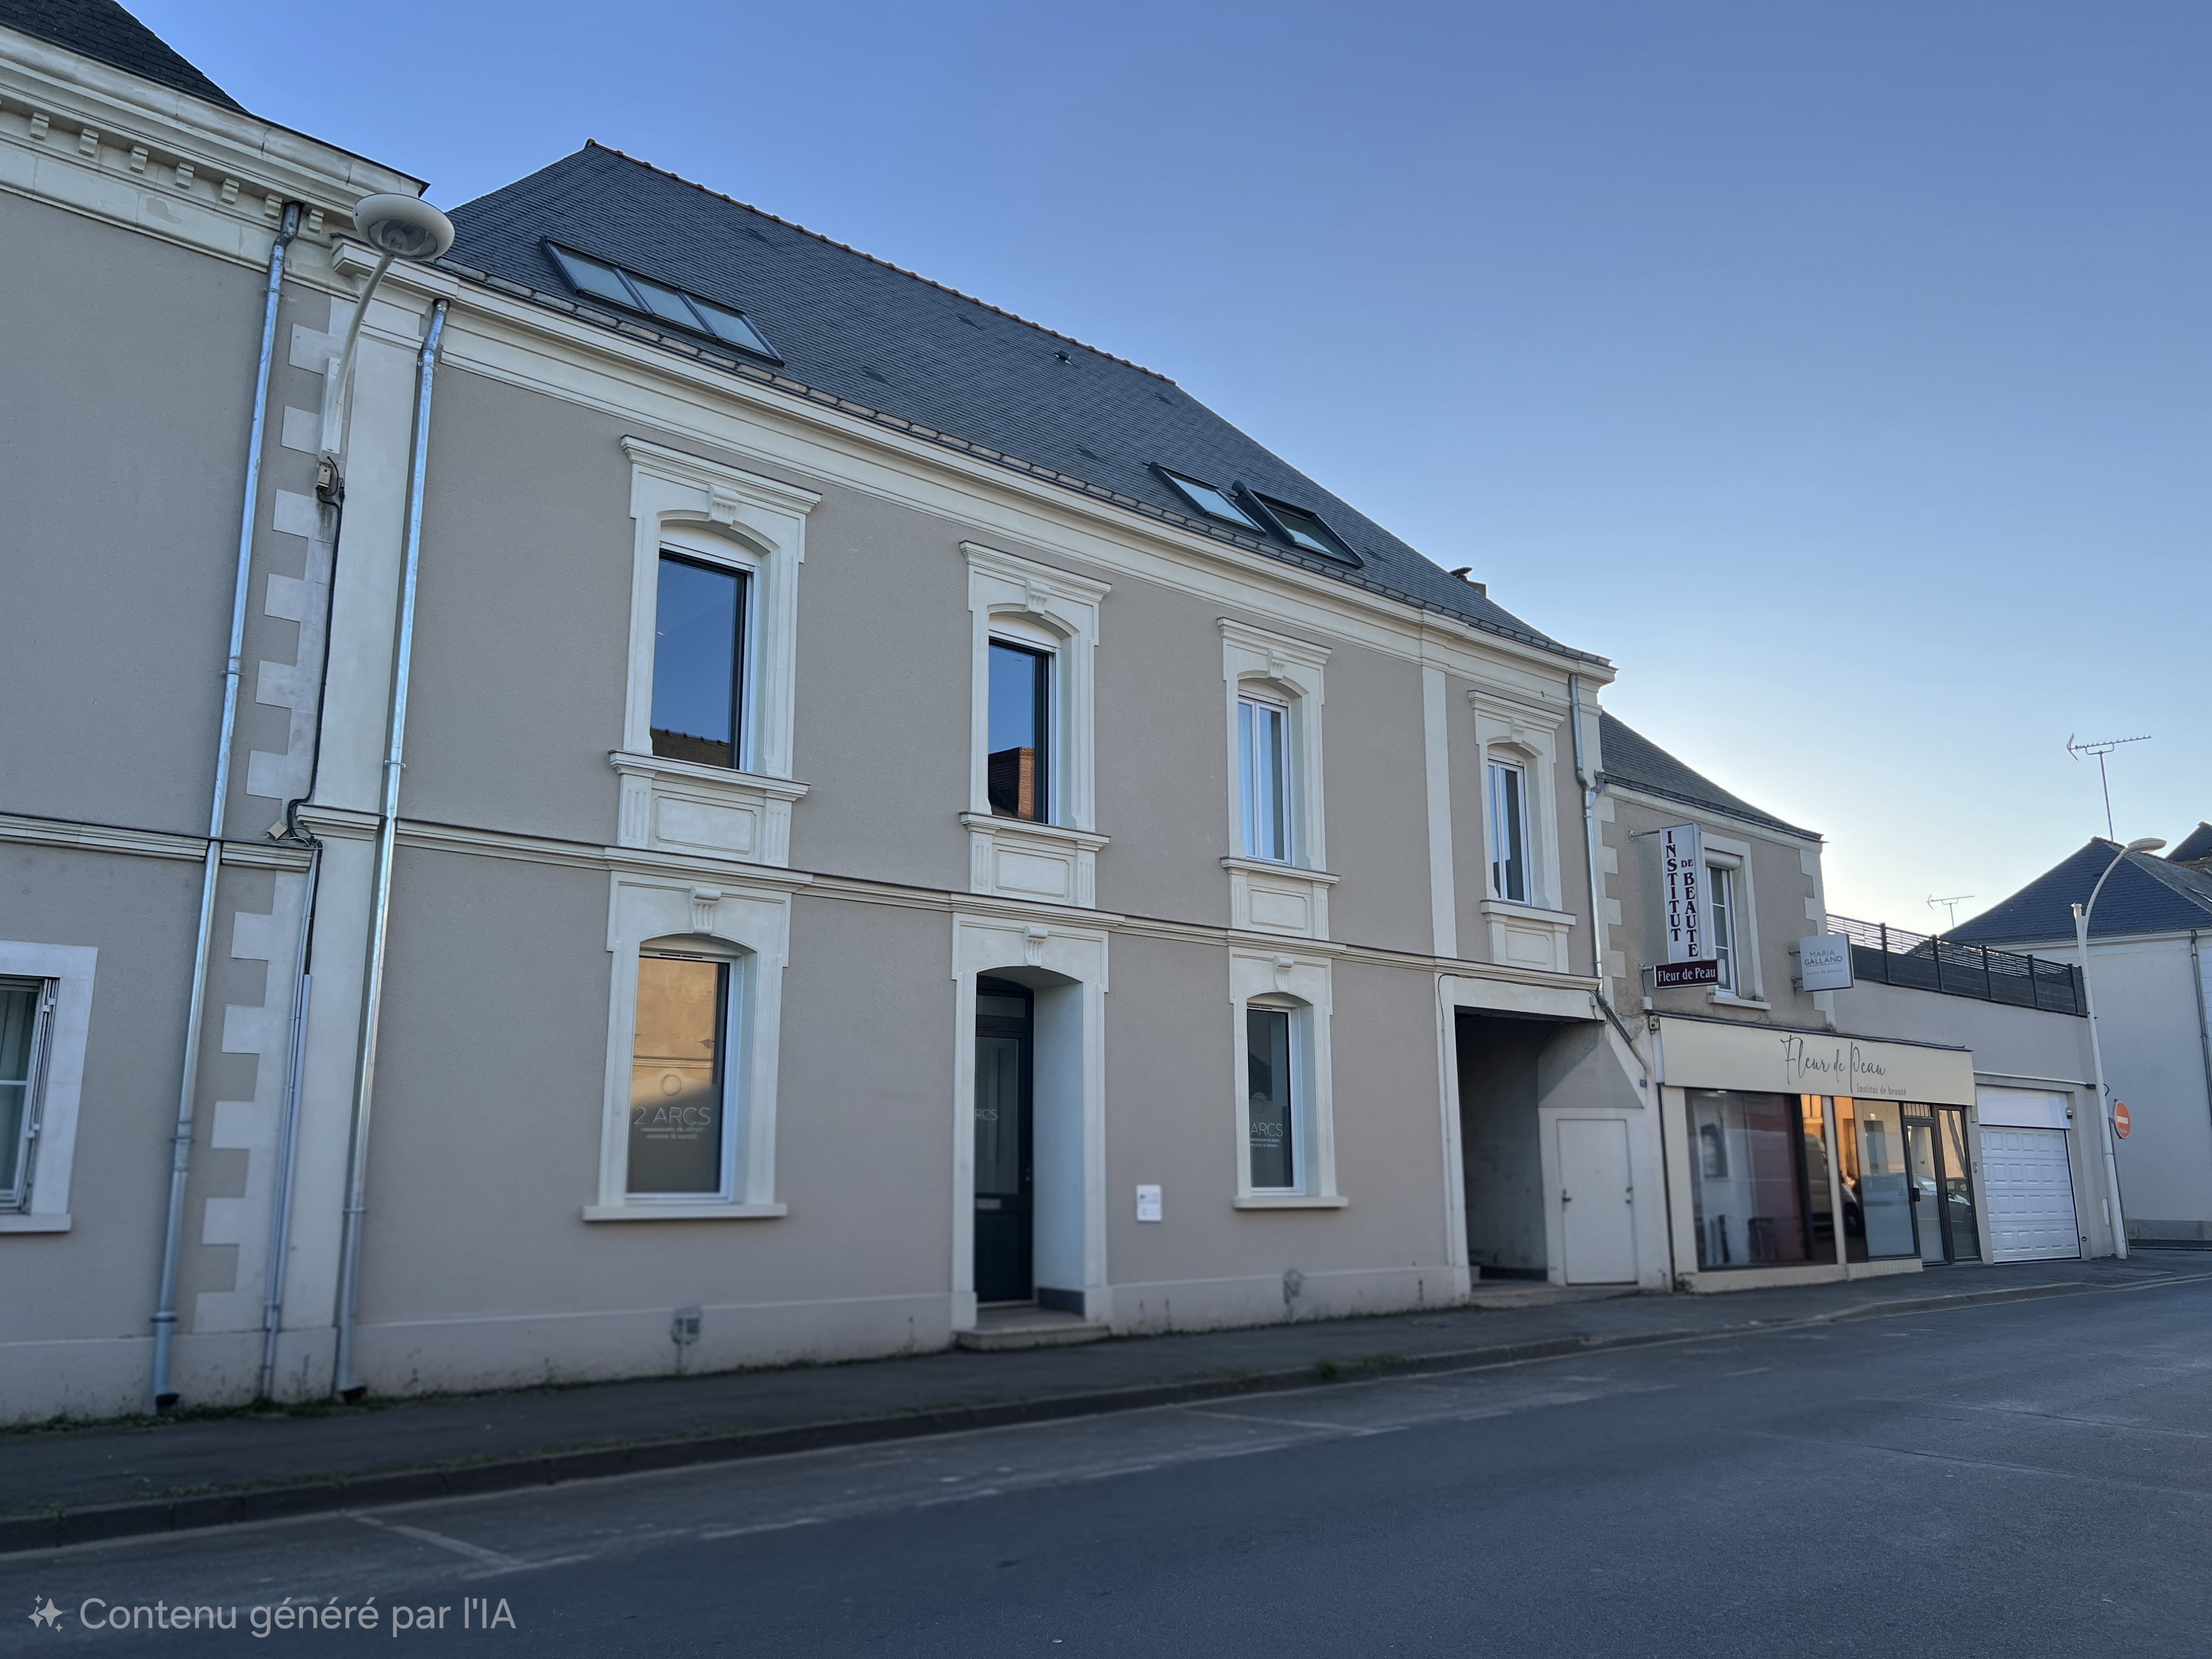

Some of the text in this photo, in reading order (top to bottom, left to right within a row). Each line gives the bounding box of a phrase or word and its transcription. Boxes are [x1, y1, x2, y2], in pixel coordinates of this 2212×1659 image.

[1666, 831, 1681, 941] INSTITUT
[1681, 859, 1698, 957] DE BEAUTE
[1804, 956, 1843, 965] GALLAND
[1658, 968, 1715, 982] Fleur de Peau
[1780, 1035, 1885, 1093] Fleur de Peau
[1856, 1083, 1906, 1095] Institut de beauté
[634, 1107, 710, 1125] 2 ARCS
[1250, 1123, 1283, 1137] ARCS
